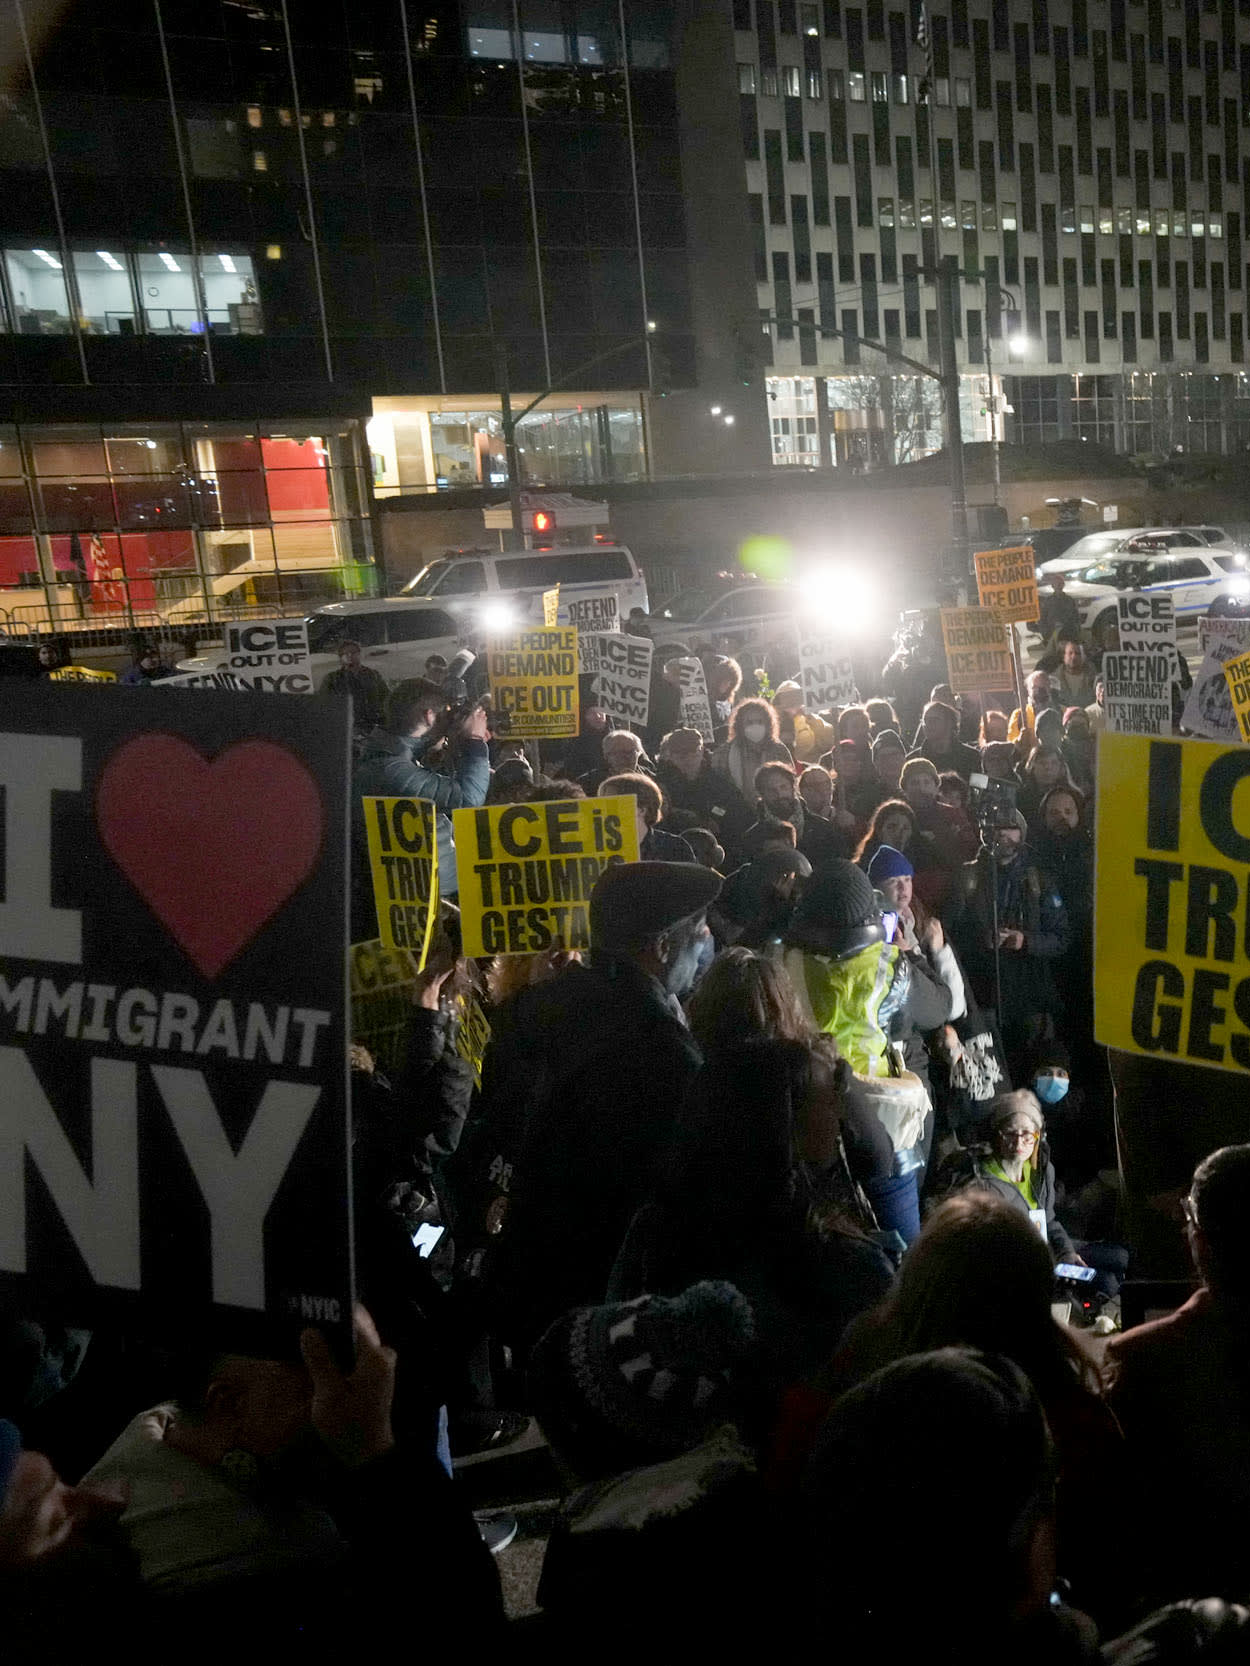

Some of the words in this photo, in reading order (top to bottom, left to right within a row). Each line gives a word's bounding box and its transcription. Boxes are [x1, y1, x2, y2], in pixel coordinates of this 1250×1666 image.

[979, 556, 997, 569] THE
[981, 565, 1033, 585] DEMAND
[983, 590, 1006, 607] ICE
[1008, 586, 1034, 606] OUT
[1119, 597, 1174, 619] ICE
[568, 597, 616, 622] DEFEND
[230, 625, 307, 653] ICE
[1121, 622, 1150, 633] OUT
[1152, 622, 1174, 633] OF
[519, 632, 575, 651] PEOPLE
[599, 637, 650, 668] ICE
[231, 654, 276, 669] OUT
[278, 653, 308, 666] OF
[492, 653, 575, 677] DEMAND
[600, 660, 626, 676] OUT
[627, 667, 649, 681] OF
[804, 658, 851, 687] NYC
[952, 652, 974, 673] ICE
[976, 651, 1007, 672] OUT
[1106, 656, 1168, 682] DEFEND
[495, 686, 528, 712] ICE
[531, 685, 575, 712] OUT
[600, 677, 648, 703] NYC
[805, 680, 853, 708] NOW
[1107, 682, 1169, 700] DEMOCRACY:
[600, 695, 647, 720] NOW
[1109, 703, 1126, 719] IT'S
[1127, 703, 1149, 720] TIME
[1150, 704, 1169, 721] FOR
[1122, 719, 1162, 734] GENERAL
[474, 801, 584, 860] ICE
[592, 808, 623, 853] is
[0, 731, 83, 964] I
[380, 856, 433, 901] TRU
[473, 854, 626, 907] TRUMP'
[480, 906, 590, 955] GESTA
[0, 975, 331, 1068] MMIGRANT
[0, 1045, 322, 1310] NY
